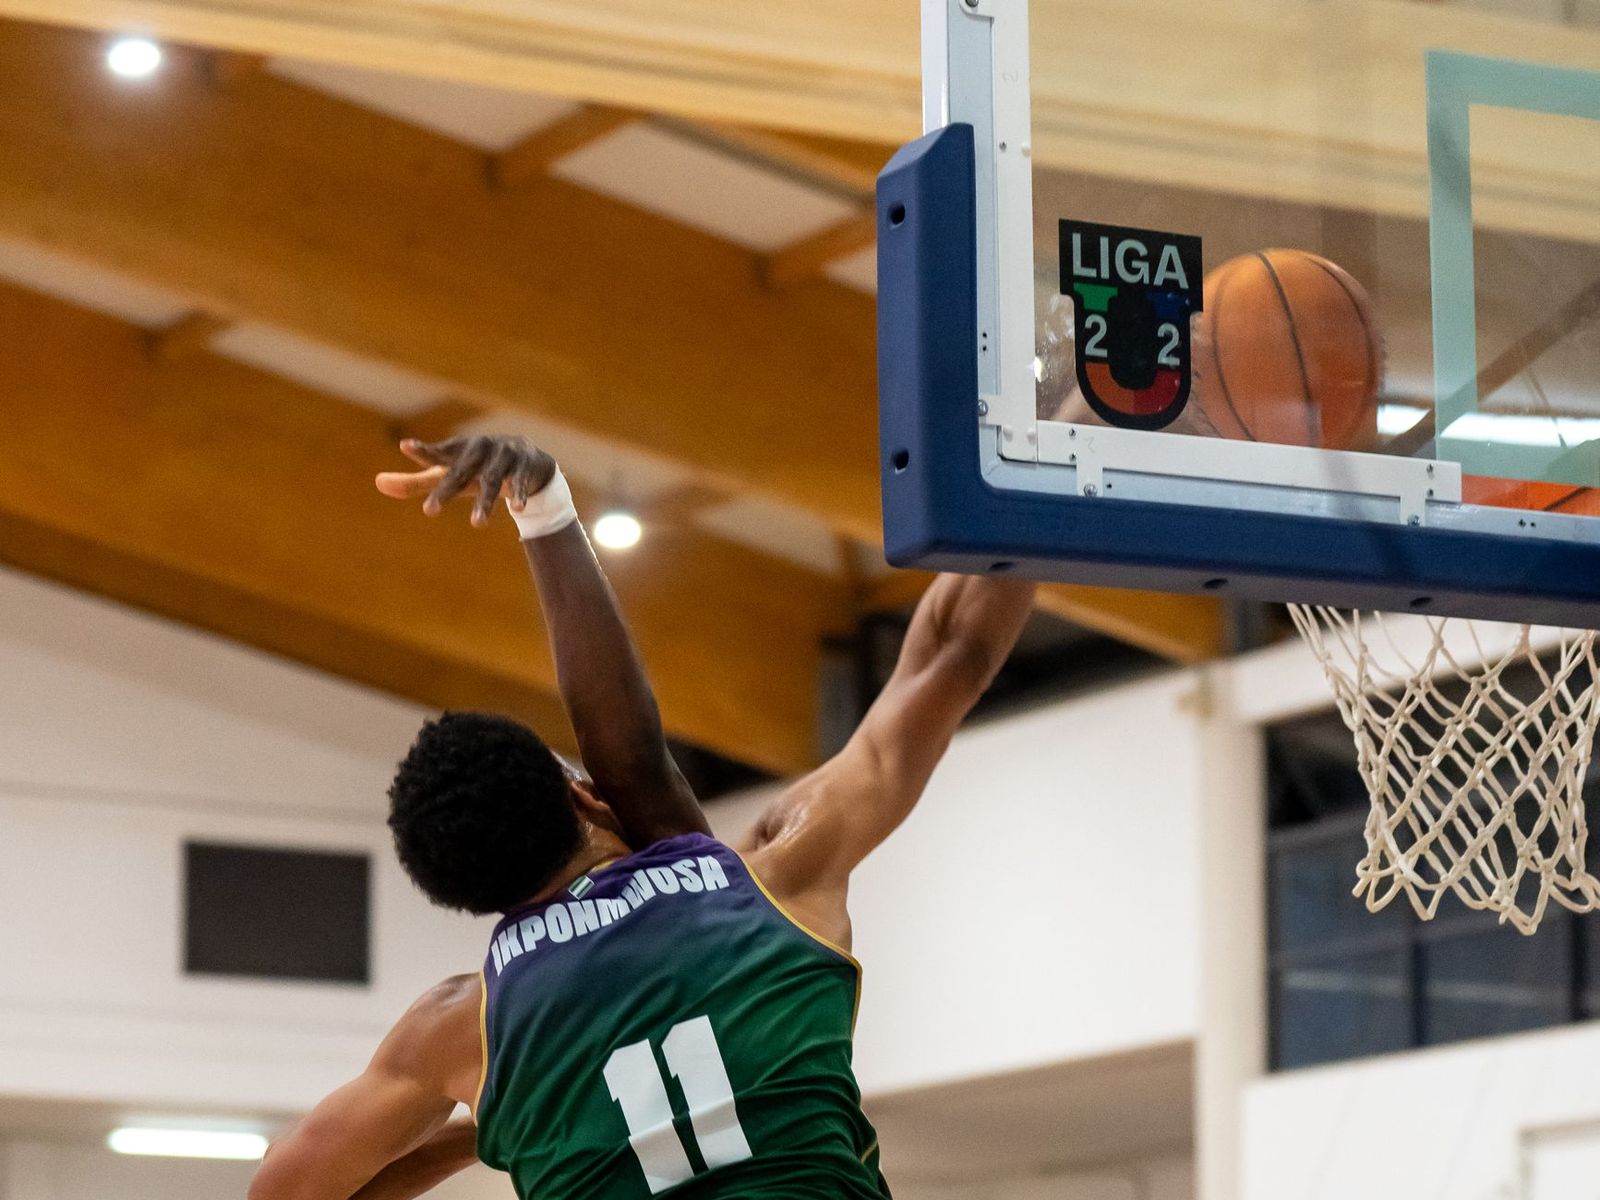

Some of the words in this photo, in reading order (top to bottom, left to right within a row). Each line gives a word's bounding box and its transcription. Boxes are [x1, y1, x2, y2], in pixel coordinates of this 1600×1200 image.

[1072, 232, 1189, 289] LIGA
[1084, 314, 1108, 358] 2
[1157, 322, 1180, 366] 2
[491, 855, 730, 976] IKPONMWOSA
[602, 1014, 753, 1195] 11
